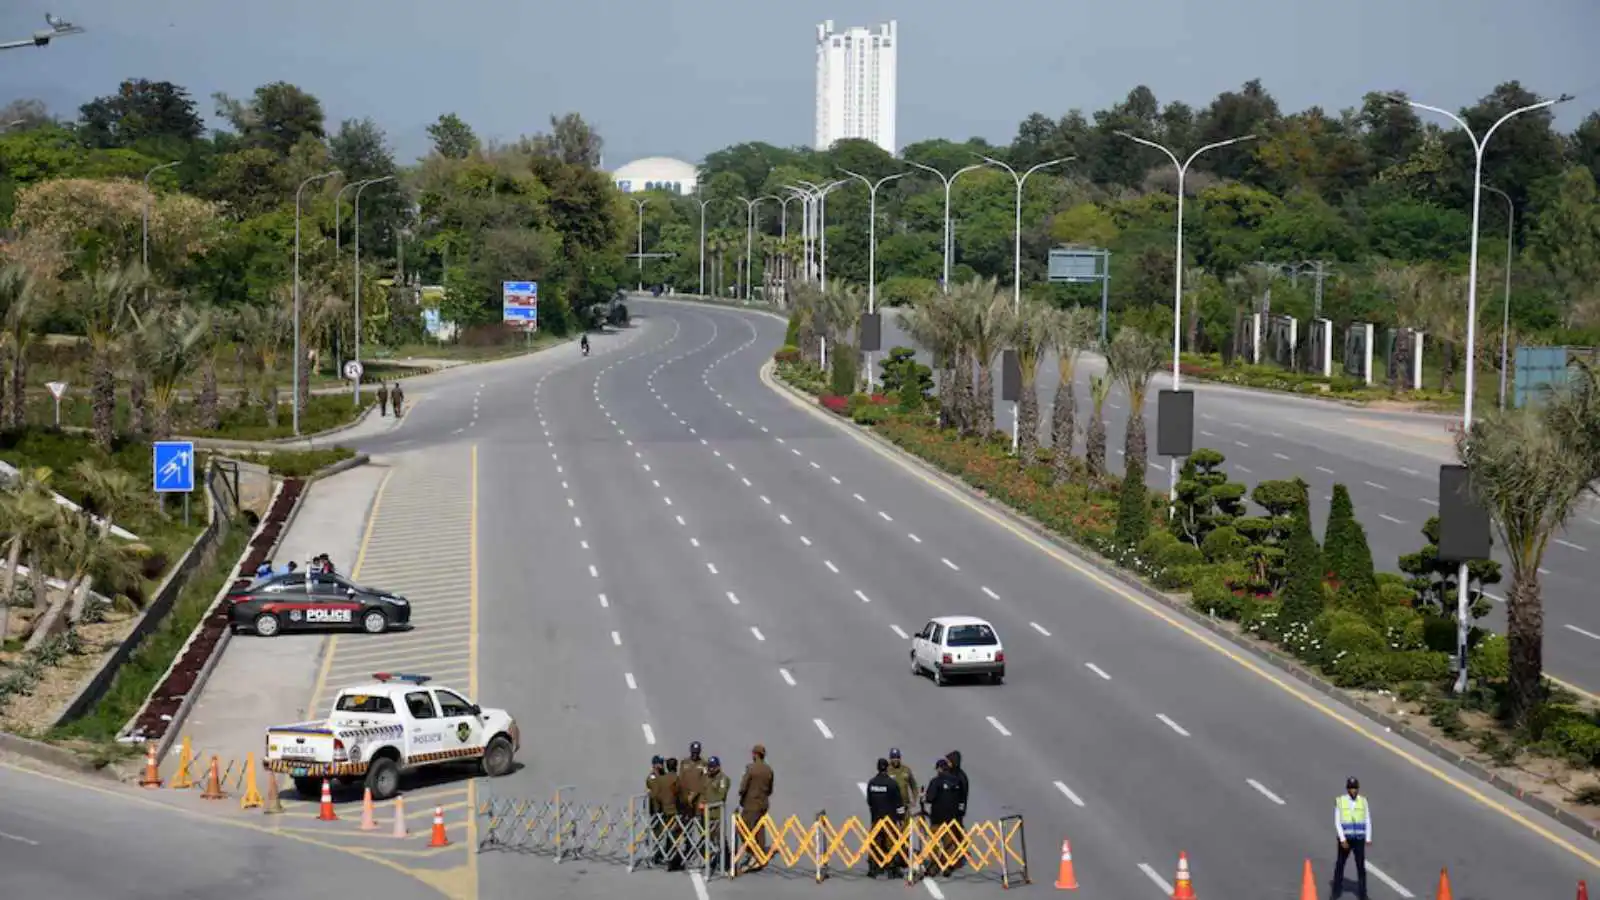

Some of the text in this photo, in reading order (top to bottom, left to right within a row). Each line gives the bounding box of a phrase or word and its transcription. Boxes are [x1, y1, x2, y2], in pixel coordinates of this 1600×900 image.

[306, 608, 351, 619] POLICE
[413, 734, 442, 745] POLICE
[282, 746, 314, 754] POLICE
